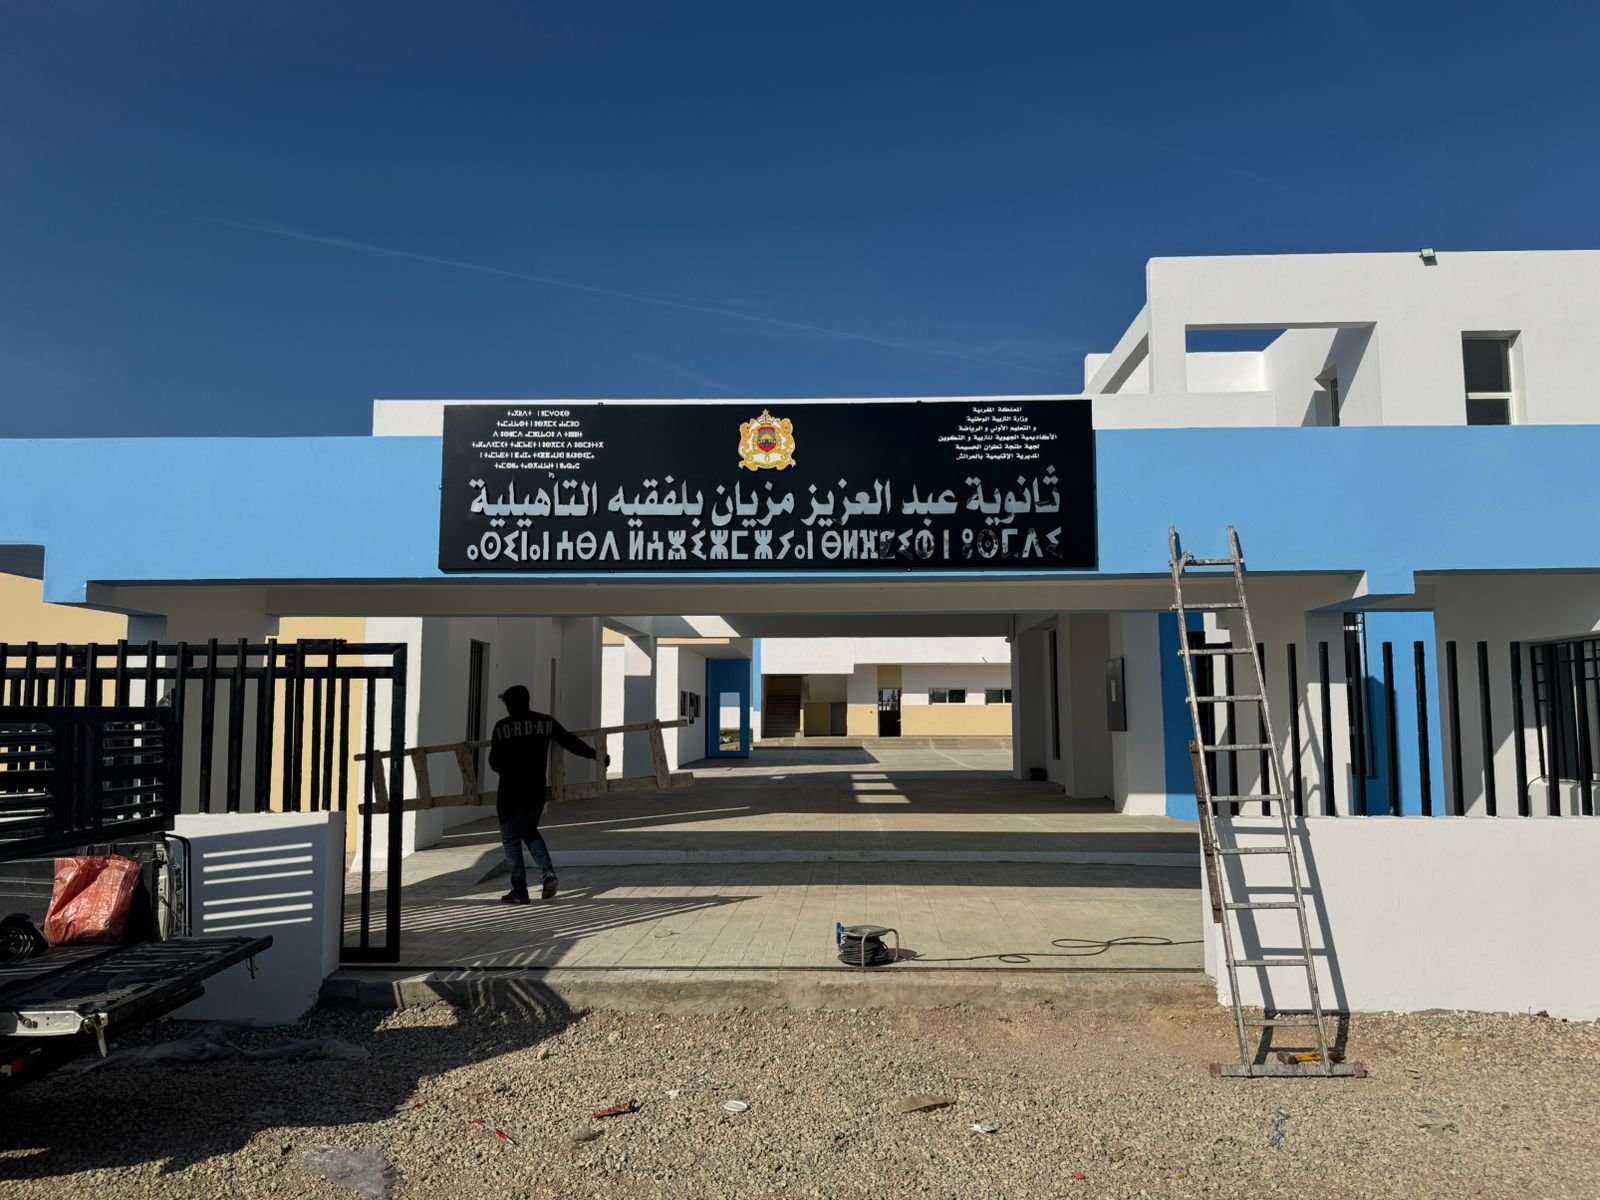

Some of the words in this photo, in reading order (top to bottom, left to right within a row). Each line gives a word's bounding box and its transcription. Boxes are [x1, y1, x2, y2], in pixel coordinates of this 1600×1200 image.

[972, 406, 995, 414] المغربية
[966, 416, 990, 424] الوطنية
[1013, 415, 1029, 423] وزارة
[958, 425, 984, 434] الرياضة
[1010, 424, 1031, 433] التعليم
[937, 434, 966, 443] التكوين
[955, 443, 982, 452] الحسيمة
[983, 443, 1003, 451] تطوان
[1004, 443, 1022, 451] طنجة
[1023, 443, 1040, 451] لجهة
[1015, 452, 1040, 460] المديرية
[468, 471, 598, 528] التأهيلية
[964, 465, 1061, 525] ثانوية
[607, 475, 704, 528] بلفقيه
[711, 480, 795, 527] مزيان
[801, 478, 891, 527] العزيز
[901, 483, 958, 527] عبد
